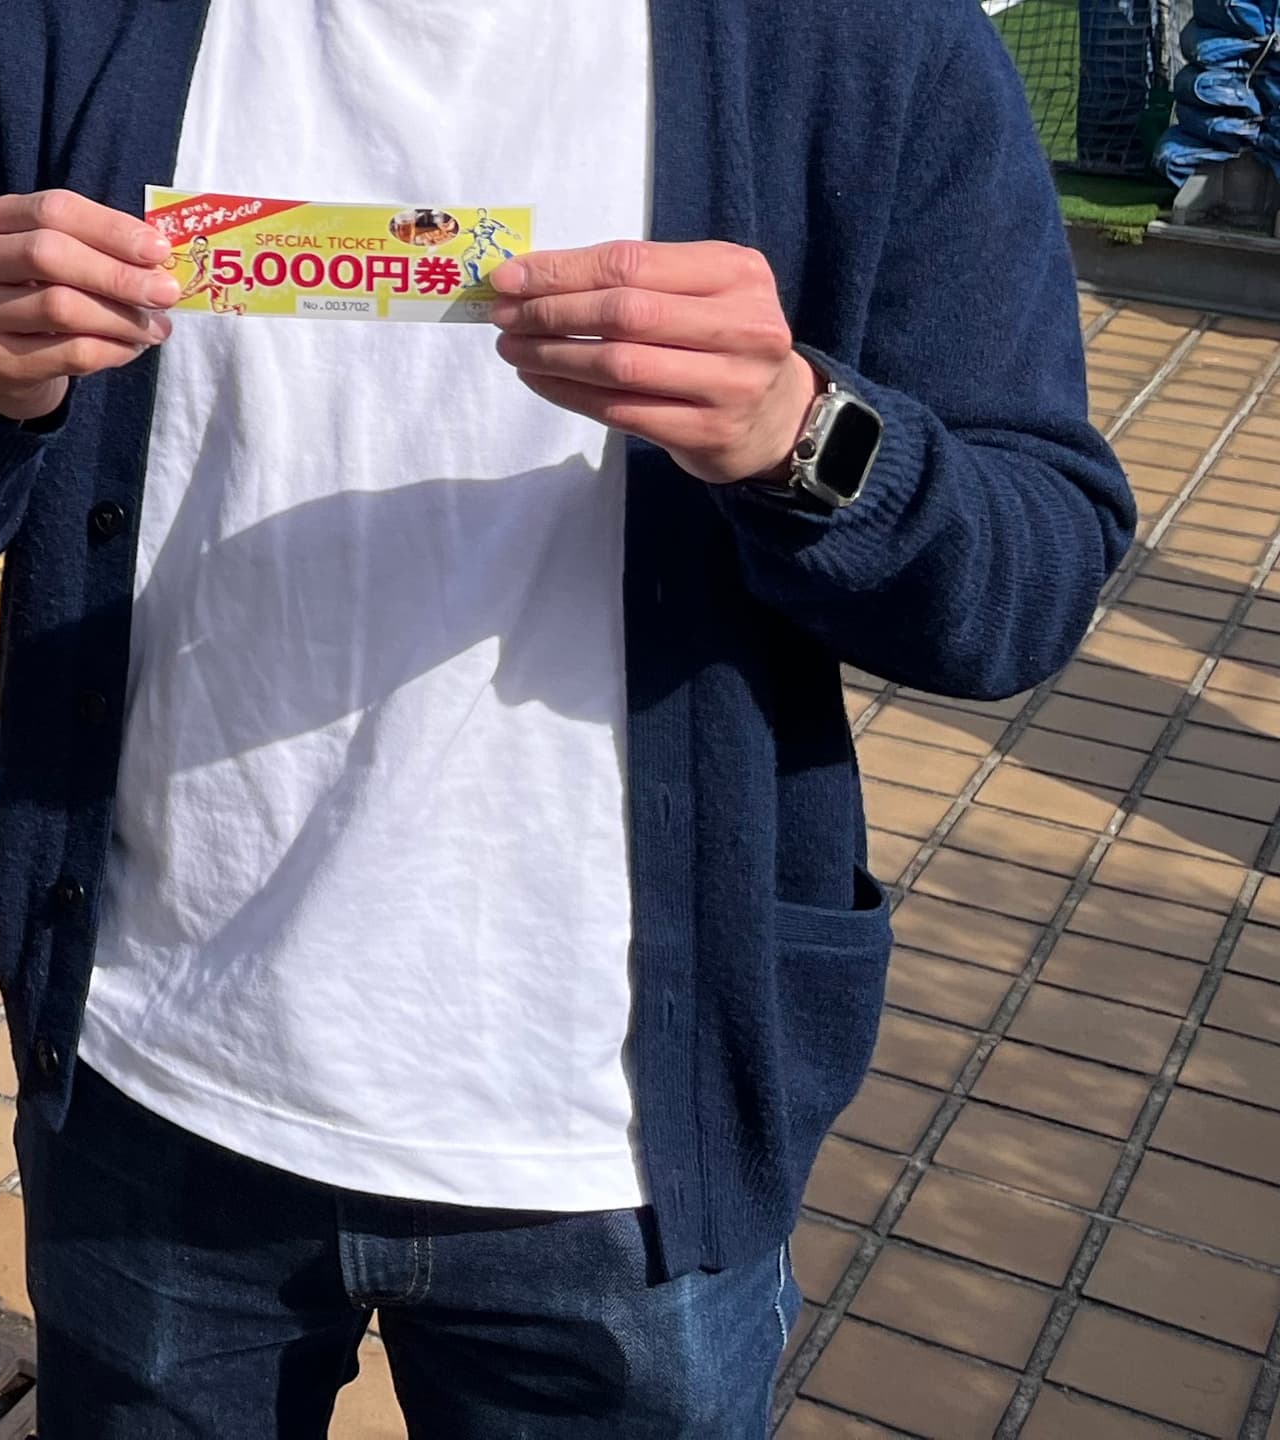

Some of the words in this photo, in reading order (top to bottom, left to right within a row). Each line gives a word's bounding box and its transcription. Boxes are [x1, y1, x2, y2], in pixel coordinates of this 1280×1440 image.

[255, 232, 321, 249] SPECIAL
[329, 236, 388, 251] TICKET
[211, 248, 462, 295] 5,000円券
